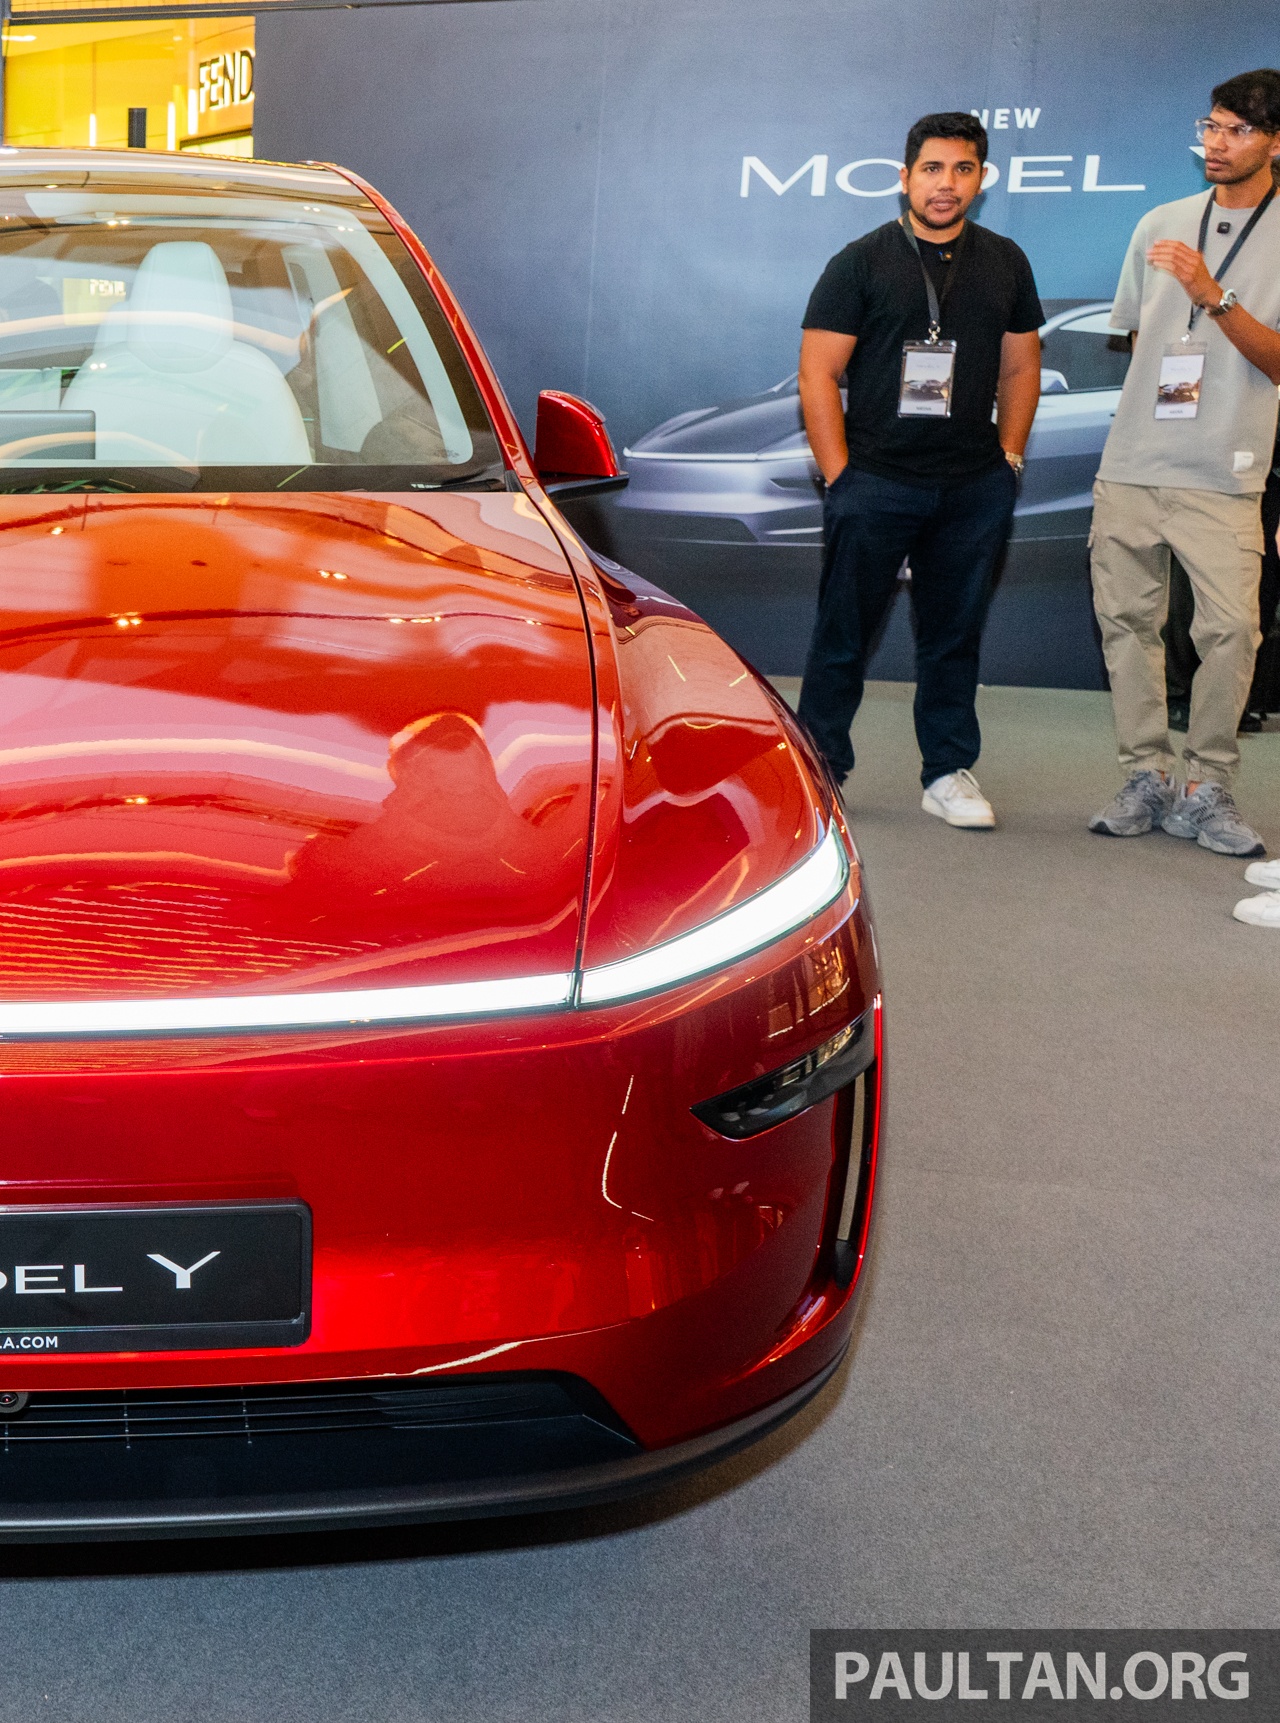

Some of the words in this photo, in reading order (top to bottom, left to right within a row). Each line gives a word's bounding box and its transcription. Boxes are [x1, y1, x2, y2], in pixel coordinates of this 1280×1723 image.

[970, 107, 1042, 130] NEW
[740, 154, 1146, 198] MOEL
[146, 1251, 221, 1289] Y
